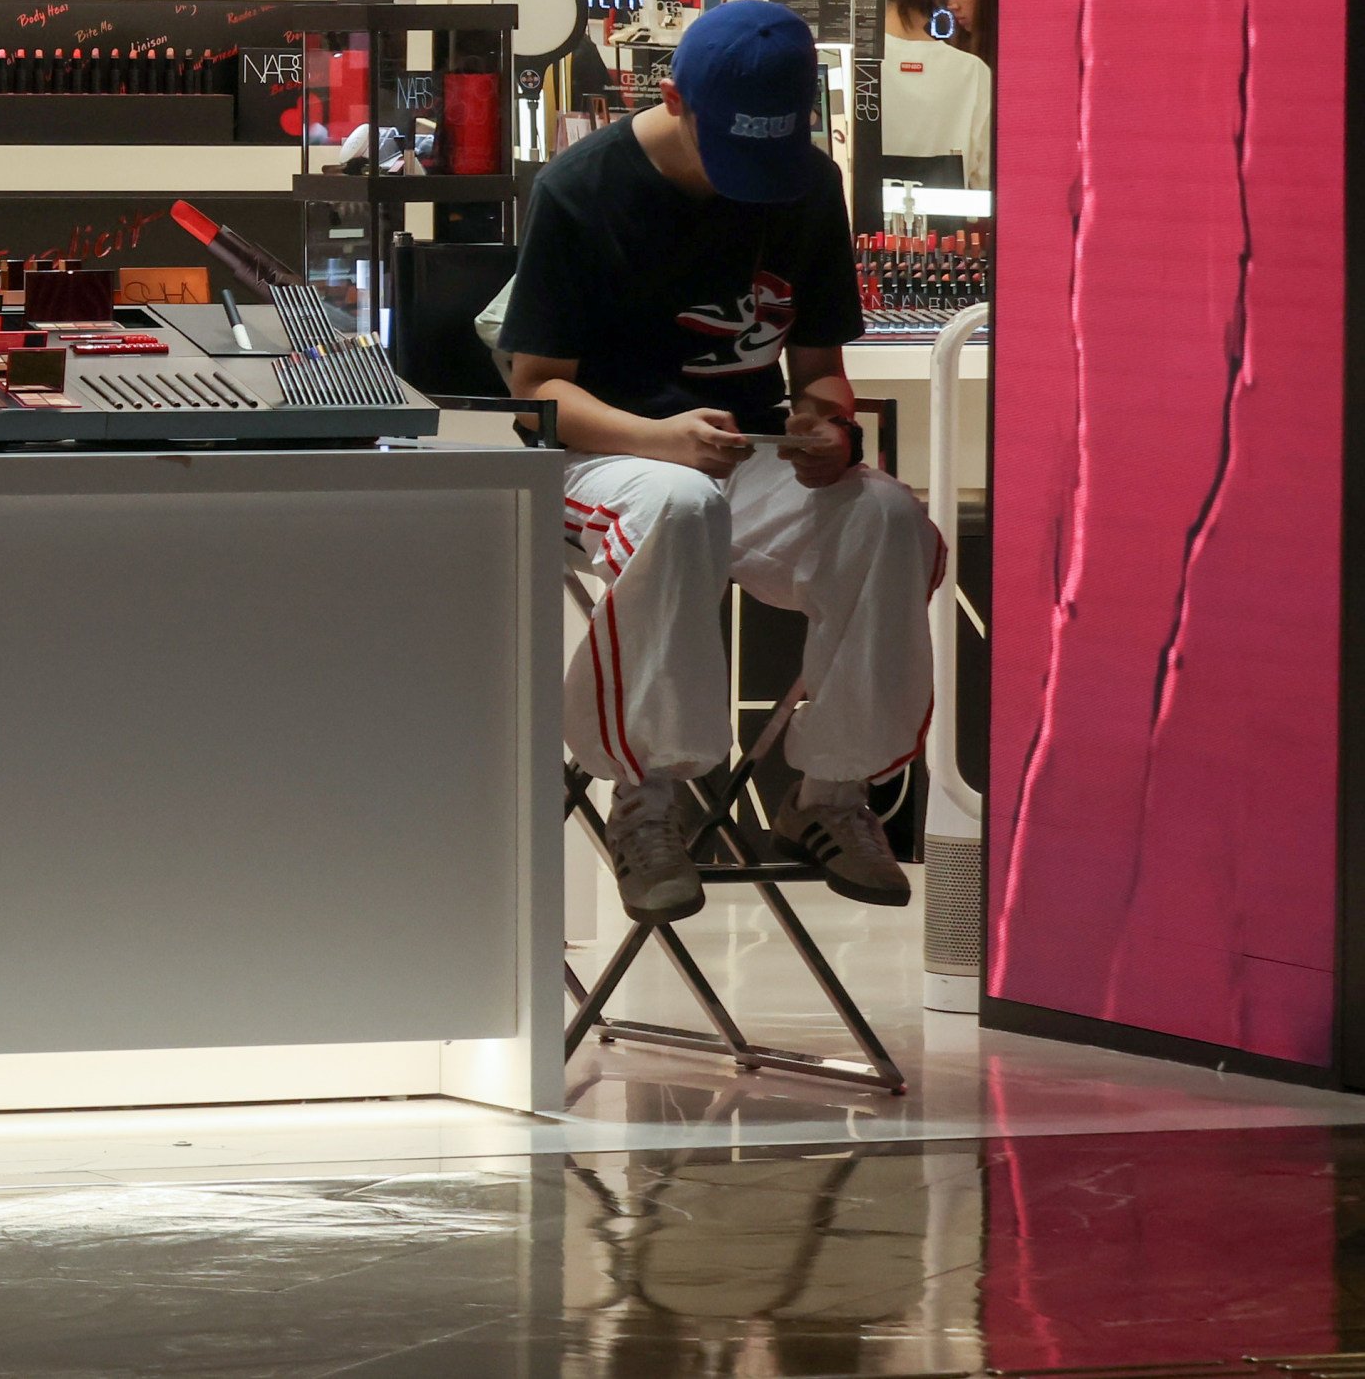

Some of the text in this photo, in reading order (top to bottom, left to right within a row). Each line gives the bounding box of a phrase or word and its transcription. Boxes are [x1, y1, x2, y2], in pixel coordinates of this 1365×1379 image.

[17, 10, 46, 28] Body
[130, 34, 169, 54] Liaison
[396, 76, 434, 110] NARS
[730, 112, 797, 138] MU
